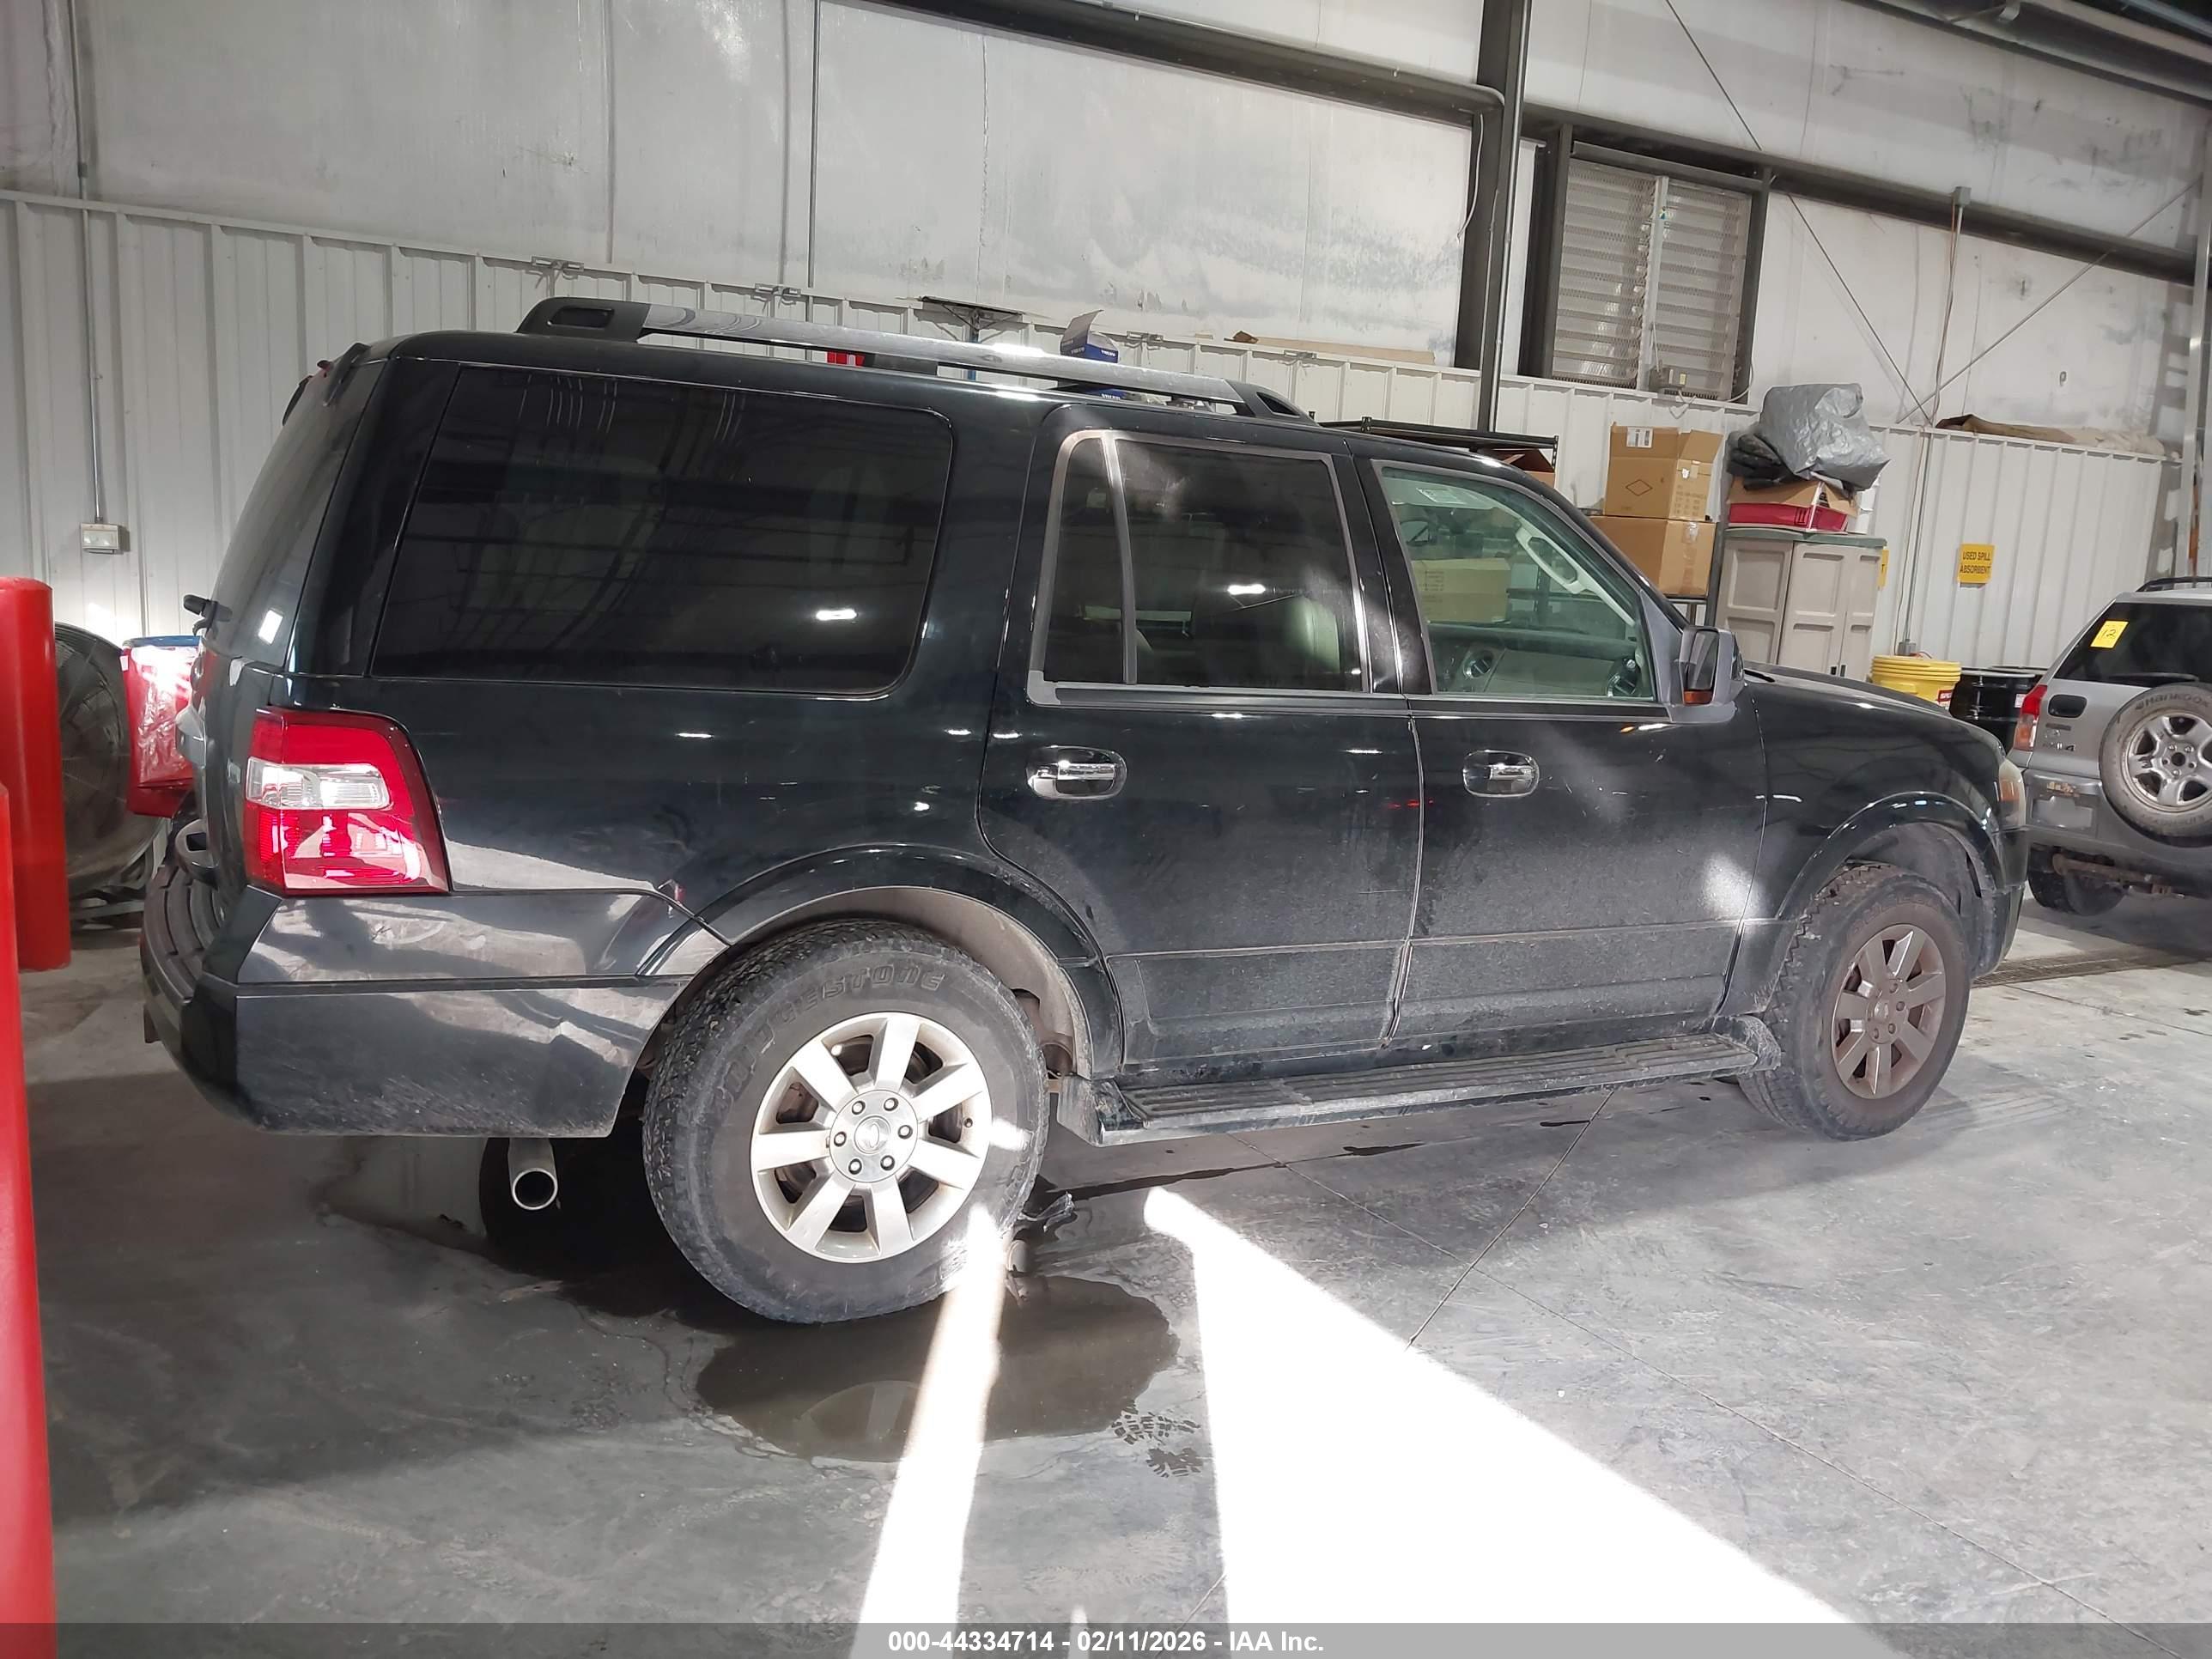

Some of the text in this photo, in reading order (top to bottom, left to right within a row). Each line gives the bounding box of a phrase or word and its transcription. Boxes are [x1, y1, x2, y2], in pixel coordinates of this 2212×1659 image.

[1962, 551, 1991, 562] USED SPILL
[1960, 563, 1991, 574] ABSORBENT
